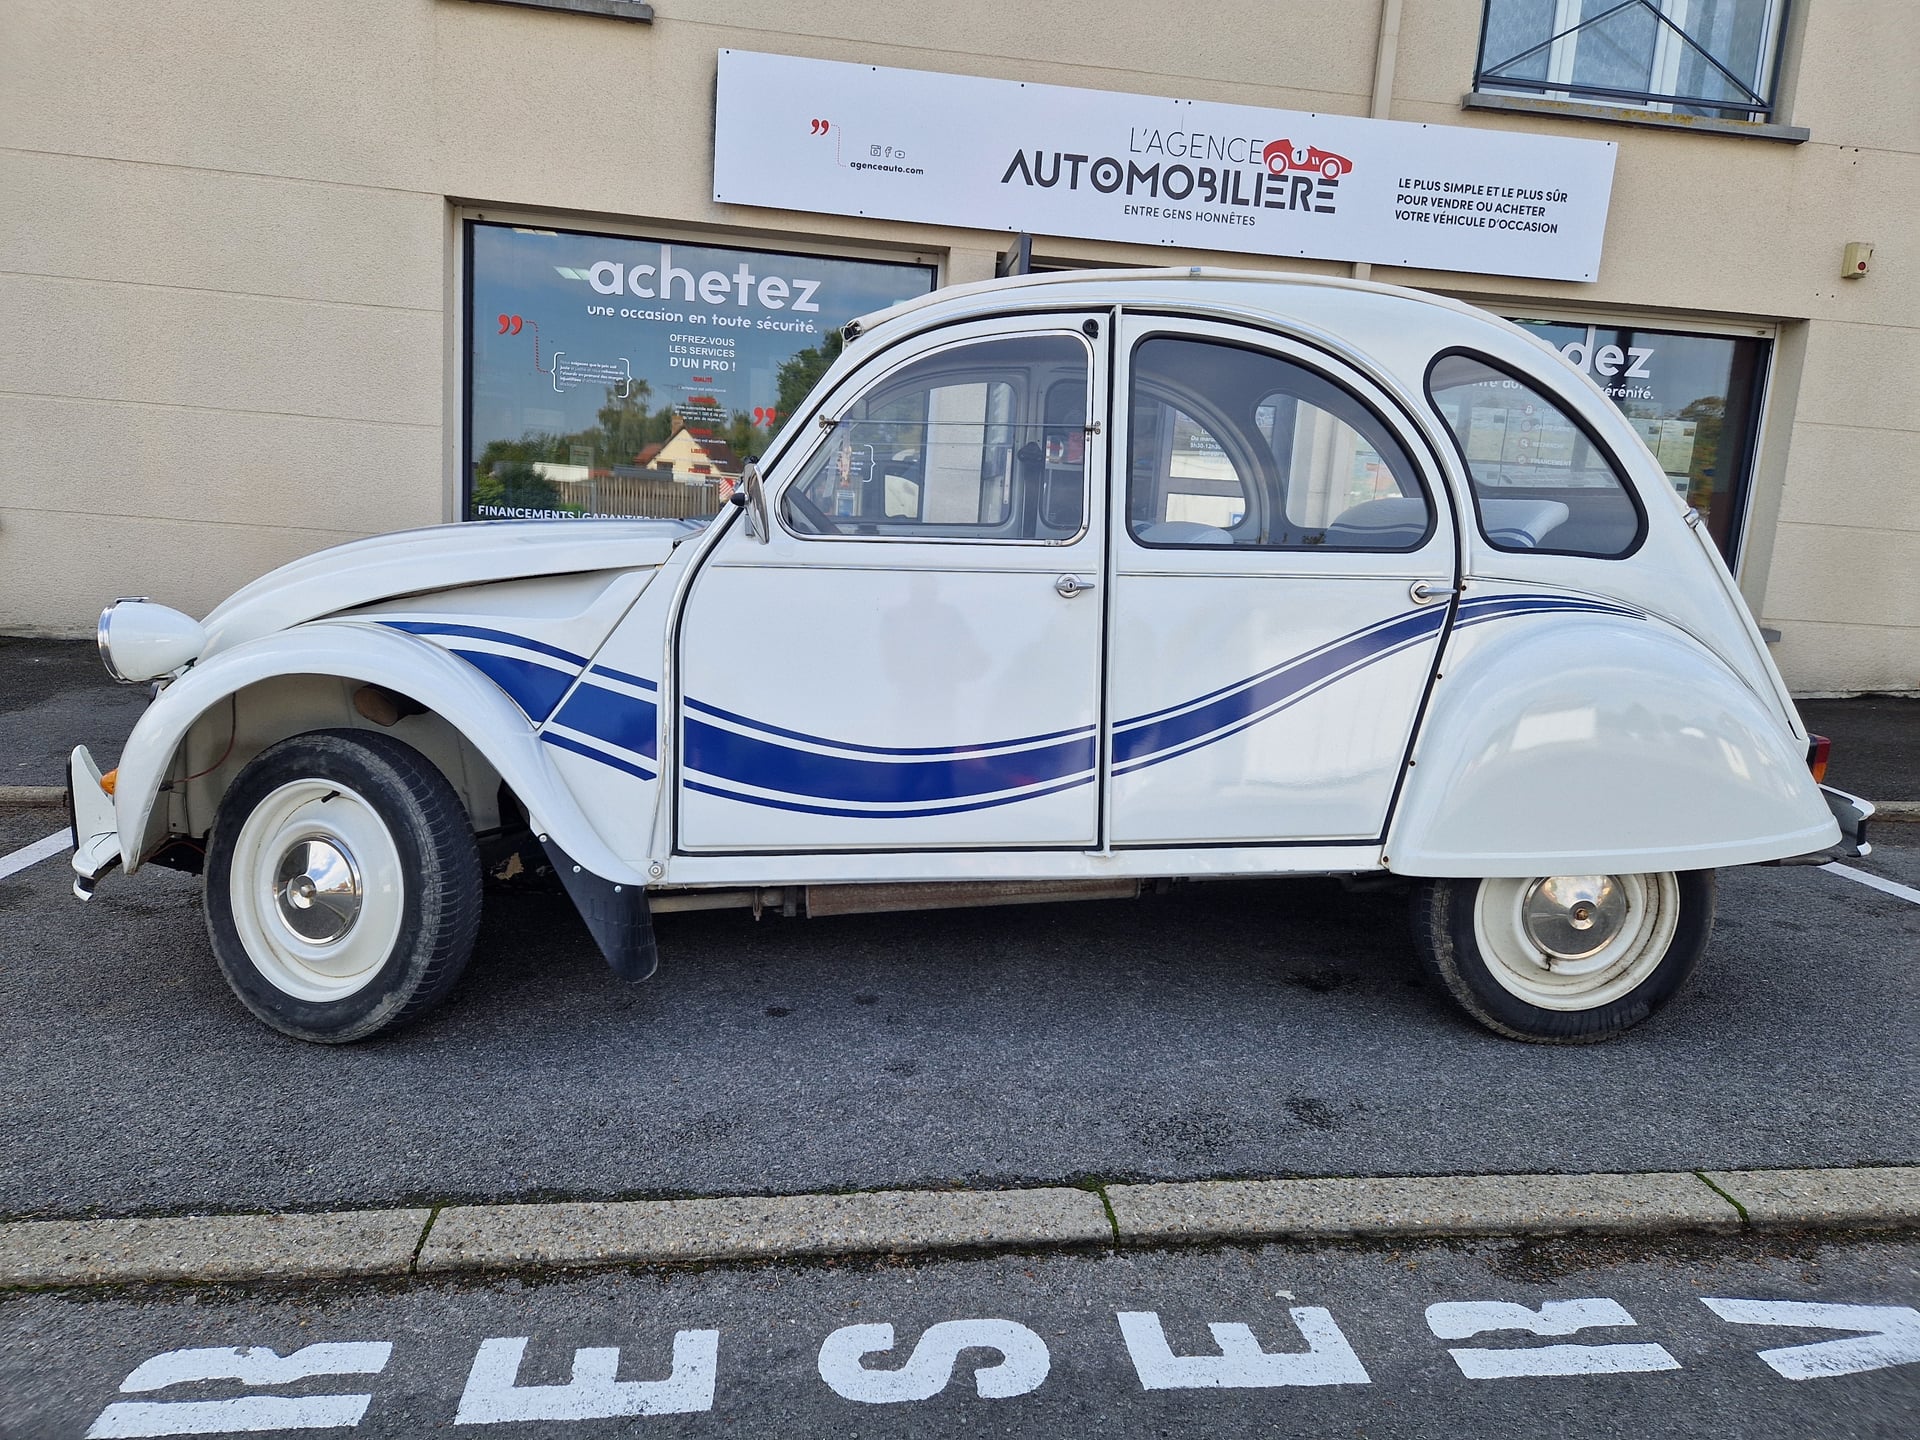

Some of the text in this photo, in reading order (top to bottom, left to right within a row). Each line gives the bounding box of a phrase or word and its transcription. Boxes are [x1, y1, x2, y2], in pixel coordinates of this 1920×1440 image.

[1129, 127, 1265, 166] L'AGENCE
[850, 161, 924, 175] agenceauto.com
[1398, 177, 1568, 203] LE PLUS SIMPLE ET LE PLUS SÛR
[1123, 204, 1256, 227] ENTRE GENS HONNÊTES
[1396, 194, 1546, 217] POUR VENDRE OU ACHETER
[1395, 209, 1558, 234] VOTRE VÉHICULE D'OCCASION
[589, 245, 822, 313] achetez
[587, 305, 818, 334] une occasion en toute sécurité.
[669, 333, 736, 347] OFFREZ-VOUS
[669, 345, 736, 358] LES SERVICES
[669, 356, 699, 369] D'UN
[703, 359, 729, 371] PRO
[1550, 325, 1655, 379] dez
[478, 505, 575, 520] FINANCEMENTS
